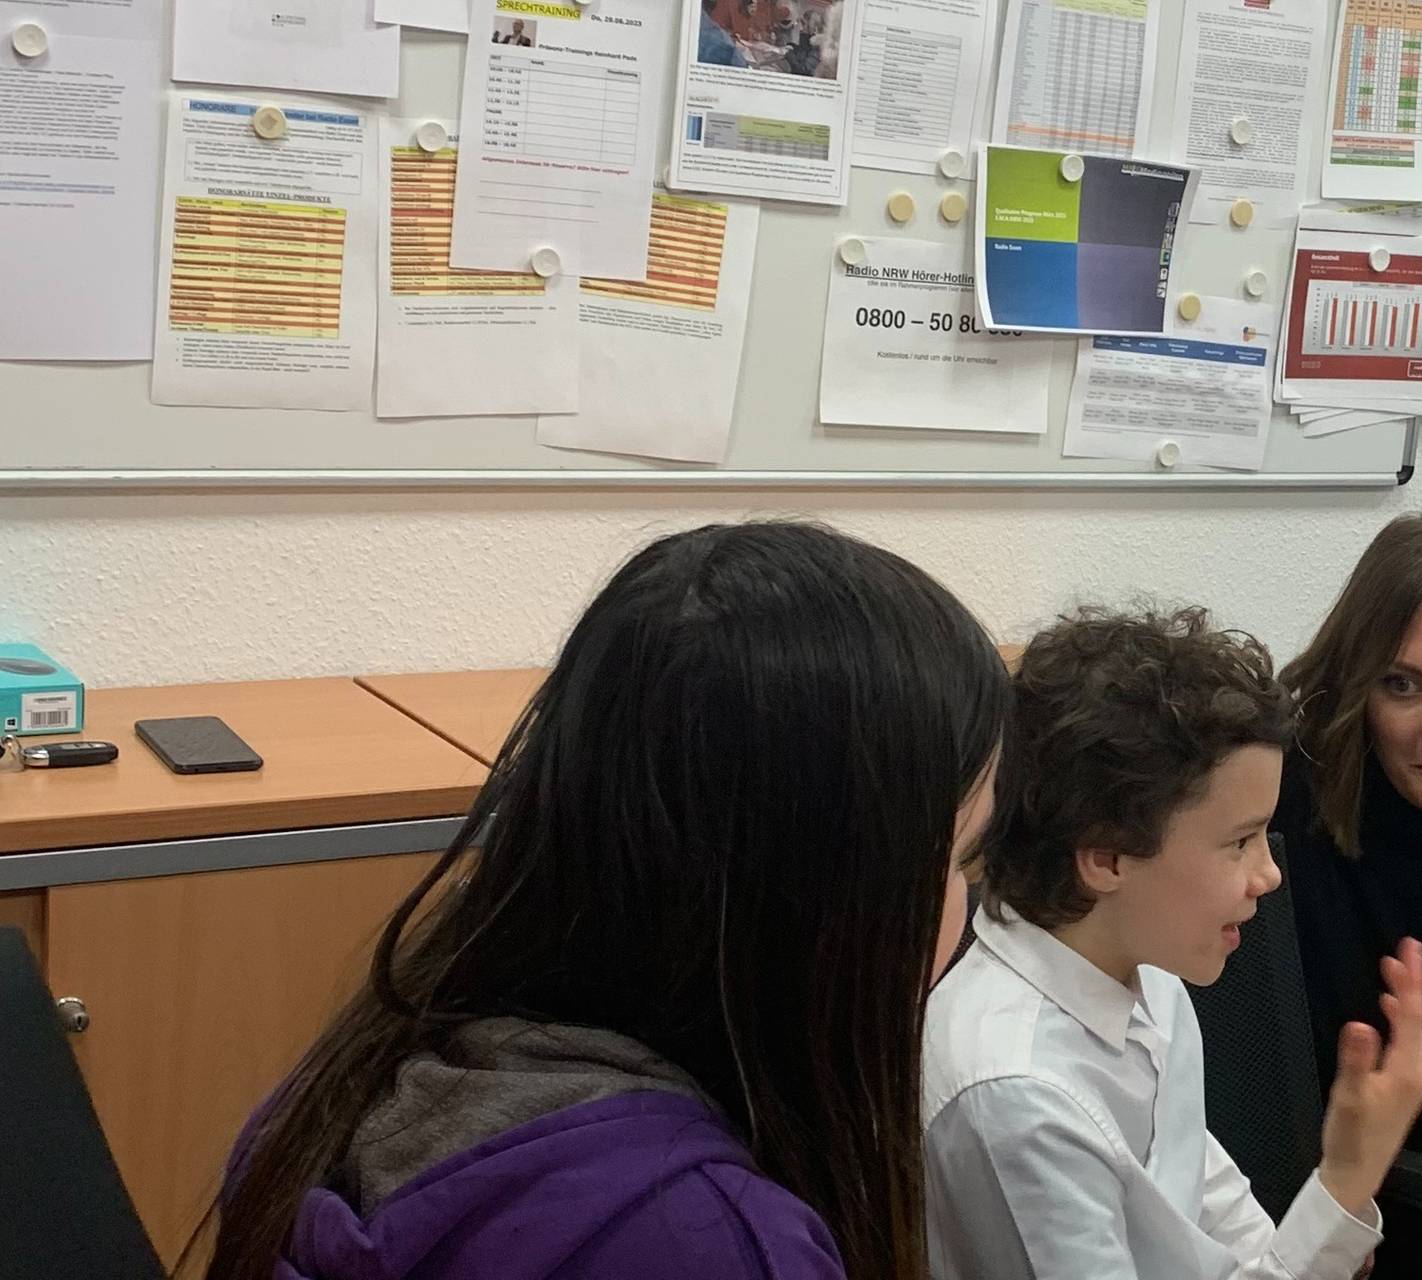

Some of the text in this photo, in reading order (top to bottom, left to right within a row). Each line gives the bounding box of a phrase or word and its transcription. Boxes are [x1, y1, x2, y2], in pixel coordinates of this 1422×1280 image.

[497, 0, 581, 18] SPRECHTRAINING
[846, 264, 974, 284] Radio NRW Hörer-Hotlin
[856, 307, 906, 329] 0800
[929, 312, 953, 332] 50
